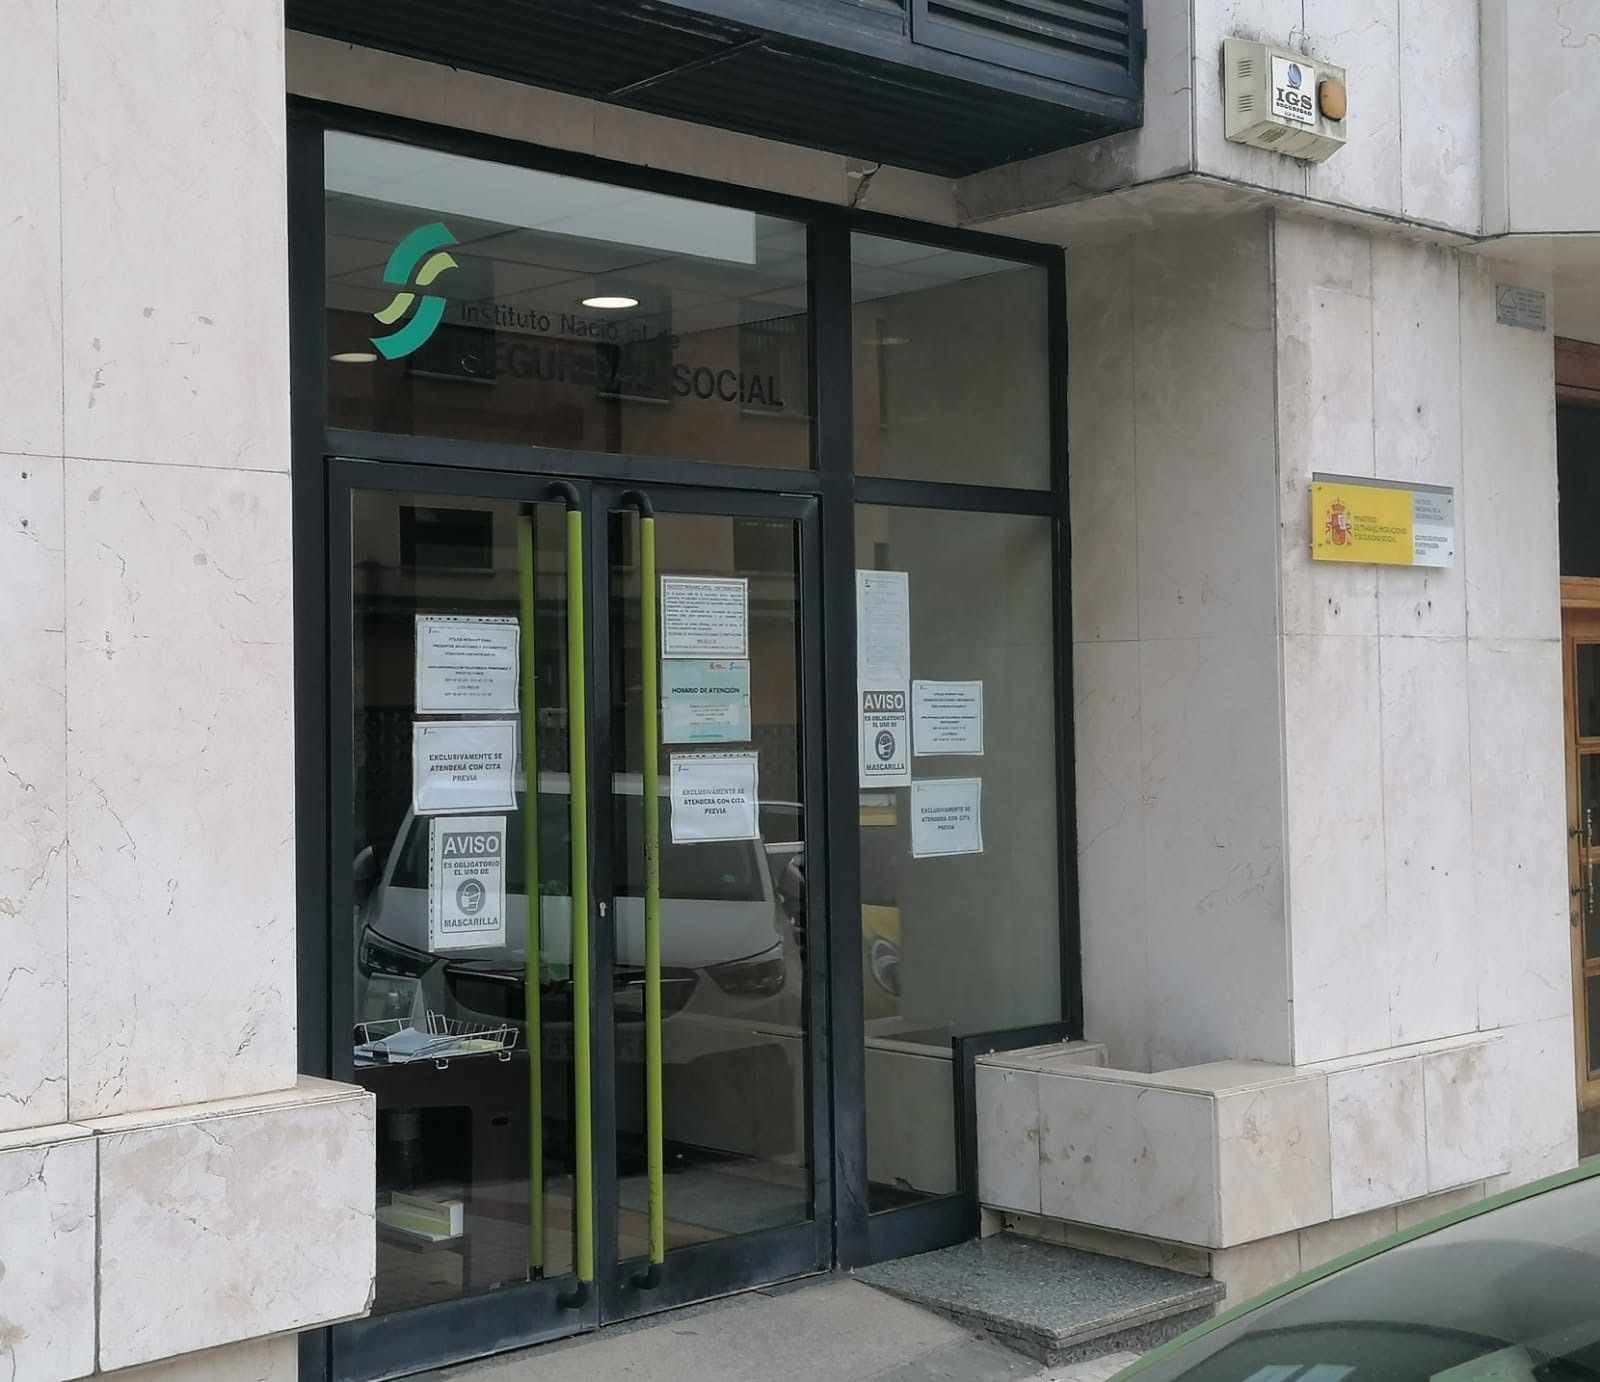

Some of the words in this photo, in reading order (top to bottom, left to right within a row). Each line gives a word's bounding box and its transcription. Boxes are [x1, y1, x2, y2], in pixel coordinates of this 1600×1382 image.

[1276, 87, 1312, 110] IGS
[461, 303, 550, 332] Instituto
[672, 363, 784, 407] SOCIAL
[864, 694, 904, 710] AVISO
[429, 753, 493, 761] EXCLUSIVAMENTE
[468, 763, 484, 771] CON
[866, 763, 905, 771] MASCARILLA
[452, 774, 478, 782] PREVIA
[717, 797, 730, 805] CON
[704, 807, 727, 815] PREVIA
[443, 835, 499, 855] AVISO
[453, 861, 500, 869] OBLIGATORIO
[454, 868, 462, 876] EL
[443, 917, 498, 928] MASCARILLA
